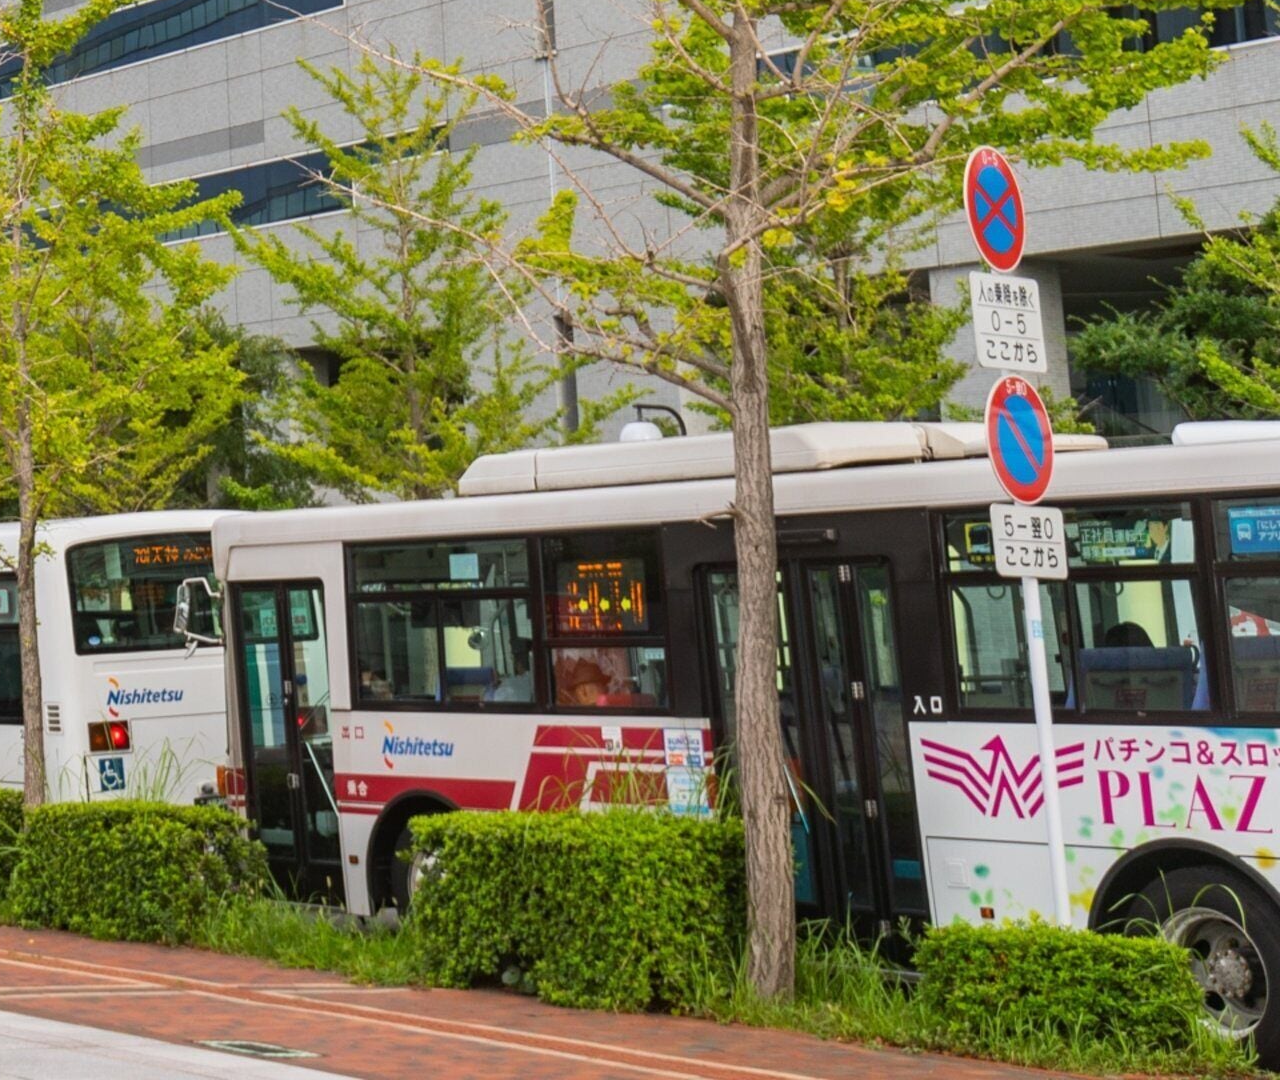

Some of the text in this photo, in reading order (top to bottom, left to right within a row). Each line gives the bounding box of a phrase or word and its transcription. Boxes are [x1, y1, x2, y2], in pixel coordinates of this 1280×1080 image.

[978, 281, 1034, 309] 人の乗降を除く
[991, 310, 1026, 334] 0-5
[986, 339, 1038, 363] ここから
[1006, 546, 1058, 568] ここから
[107, 689, 184, 705] Nishitetsu
[913, 695, 943, 714] 入口
[382, 736, 455, 756] Nishitetsu
[1097, 770, 1273, 834] PLAZ
